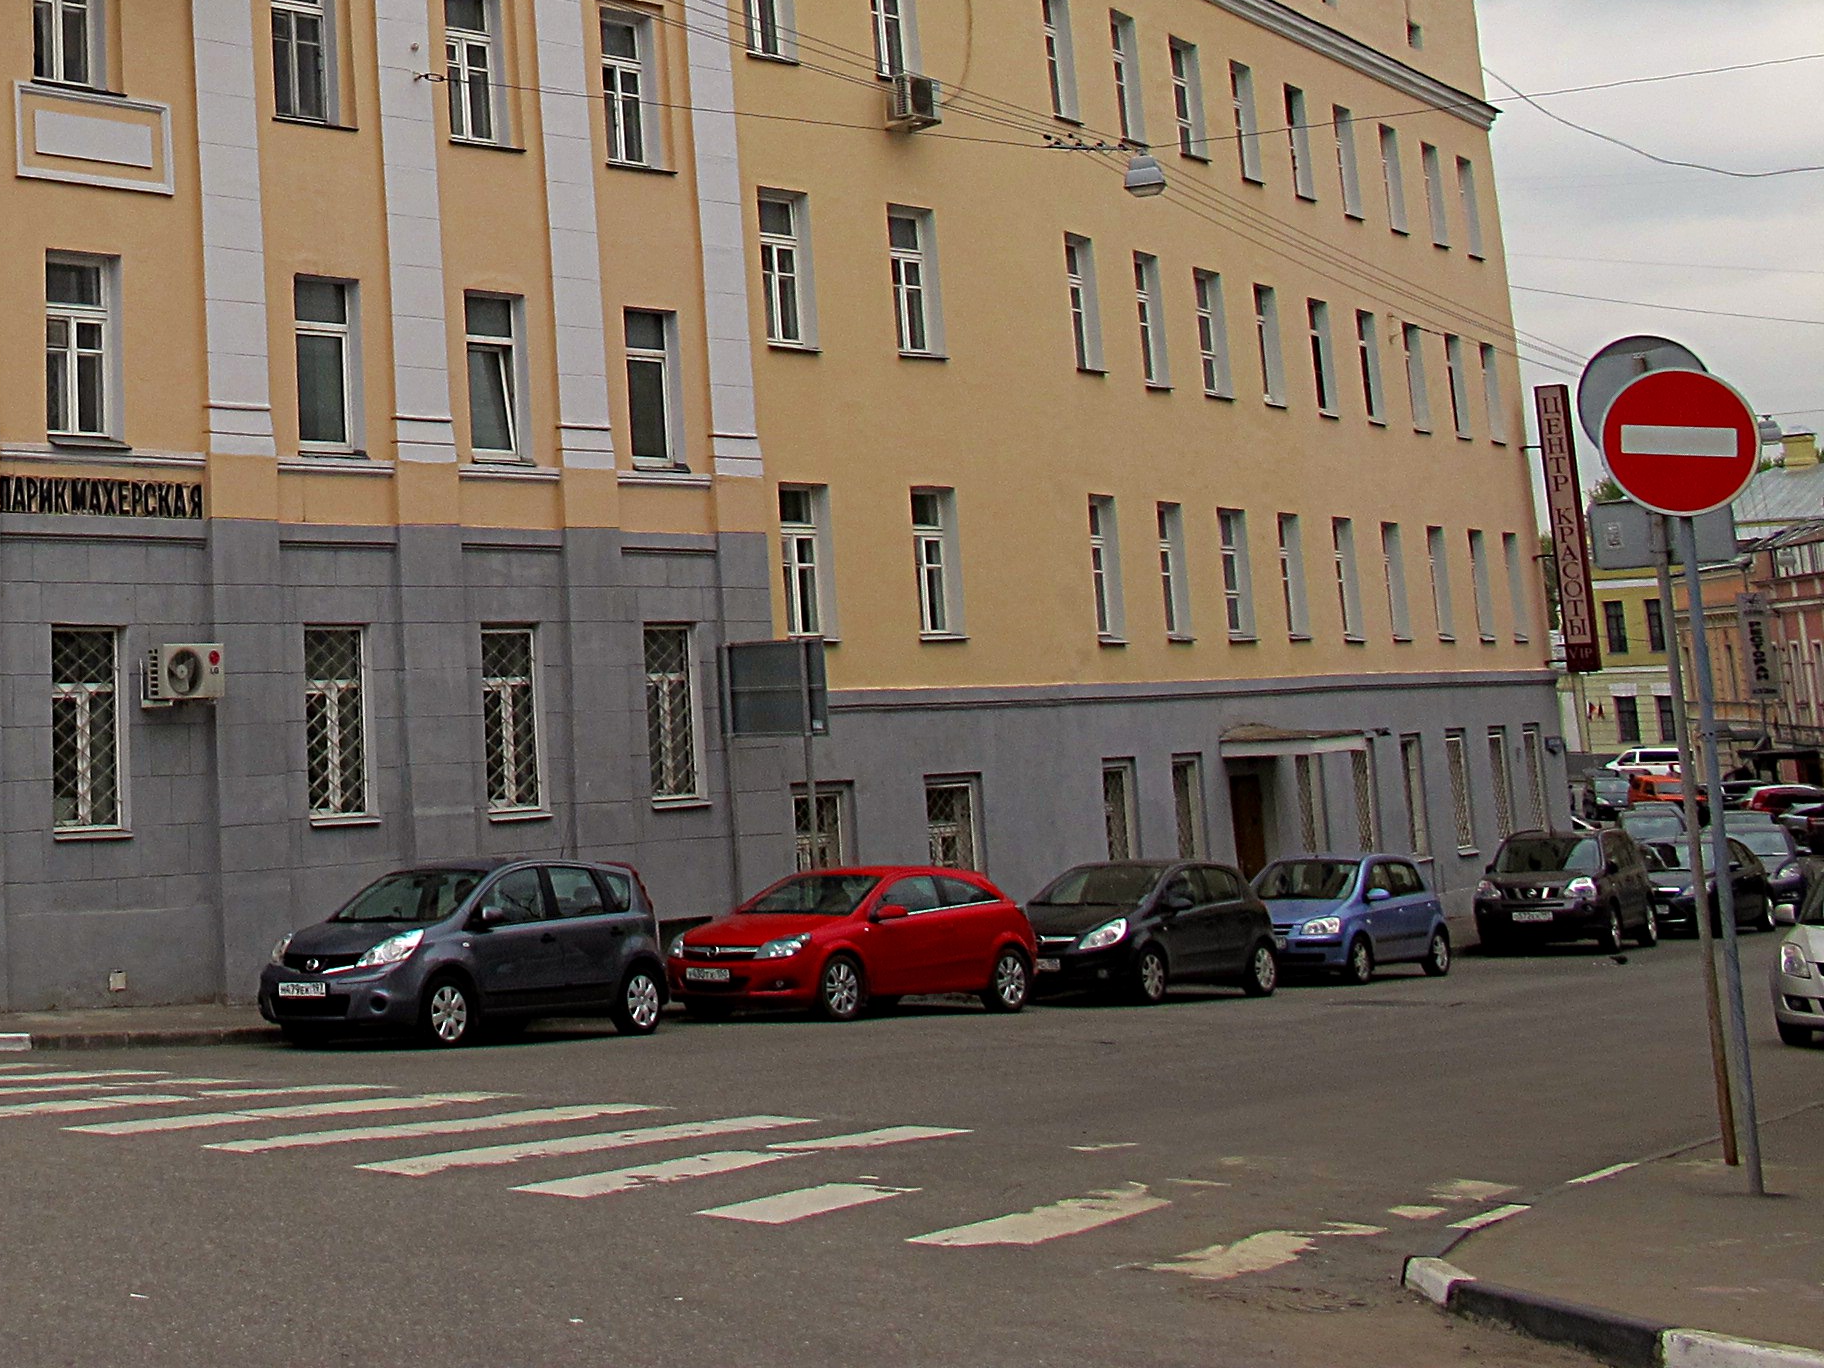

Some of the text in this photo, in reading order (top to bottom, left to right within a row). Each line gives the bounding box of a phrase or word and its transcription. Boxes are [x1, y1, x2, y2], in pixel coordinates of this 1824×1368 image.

[0, 475, 203, 520] ПАРИКМАХЕРСКАЯ
[1542, 396, 1587, 636] ЦЕНТР КРАСОТЫ
[1568, 647, 1593, 660] VIP
